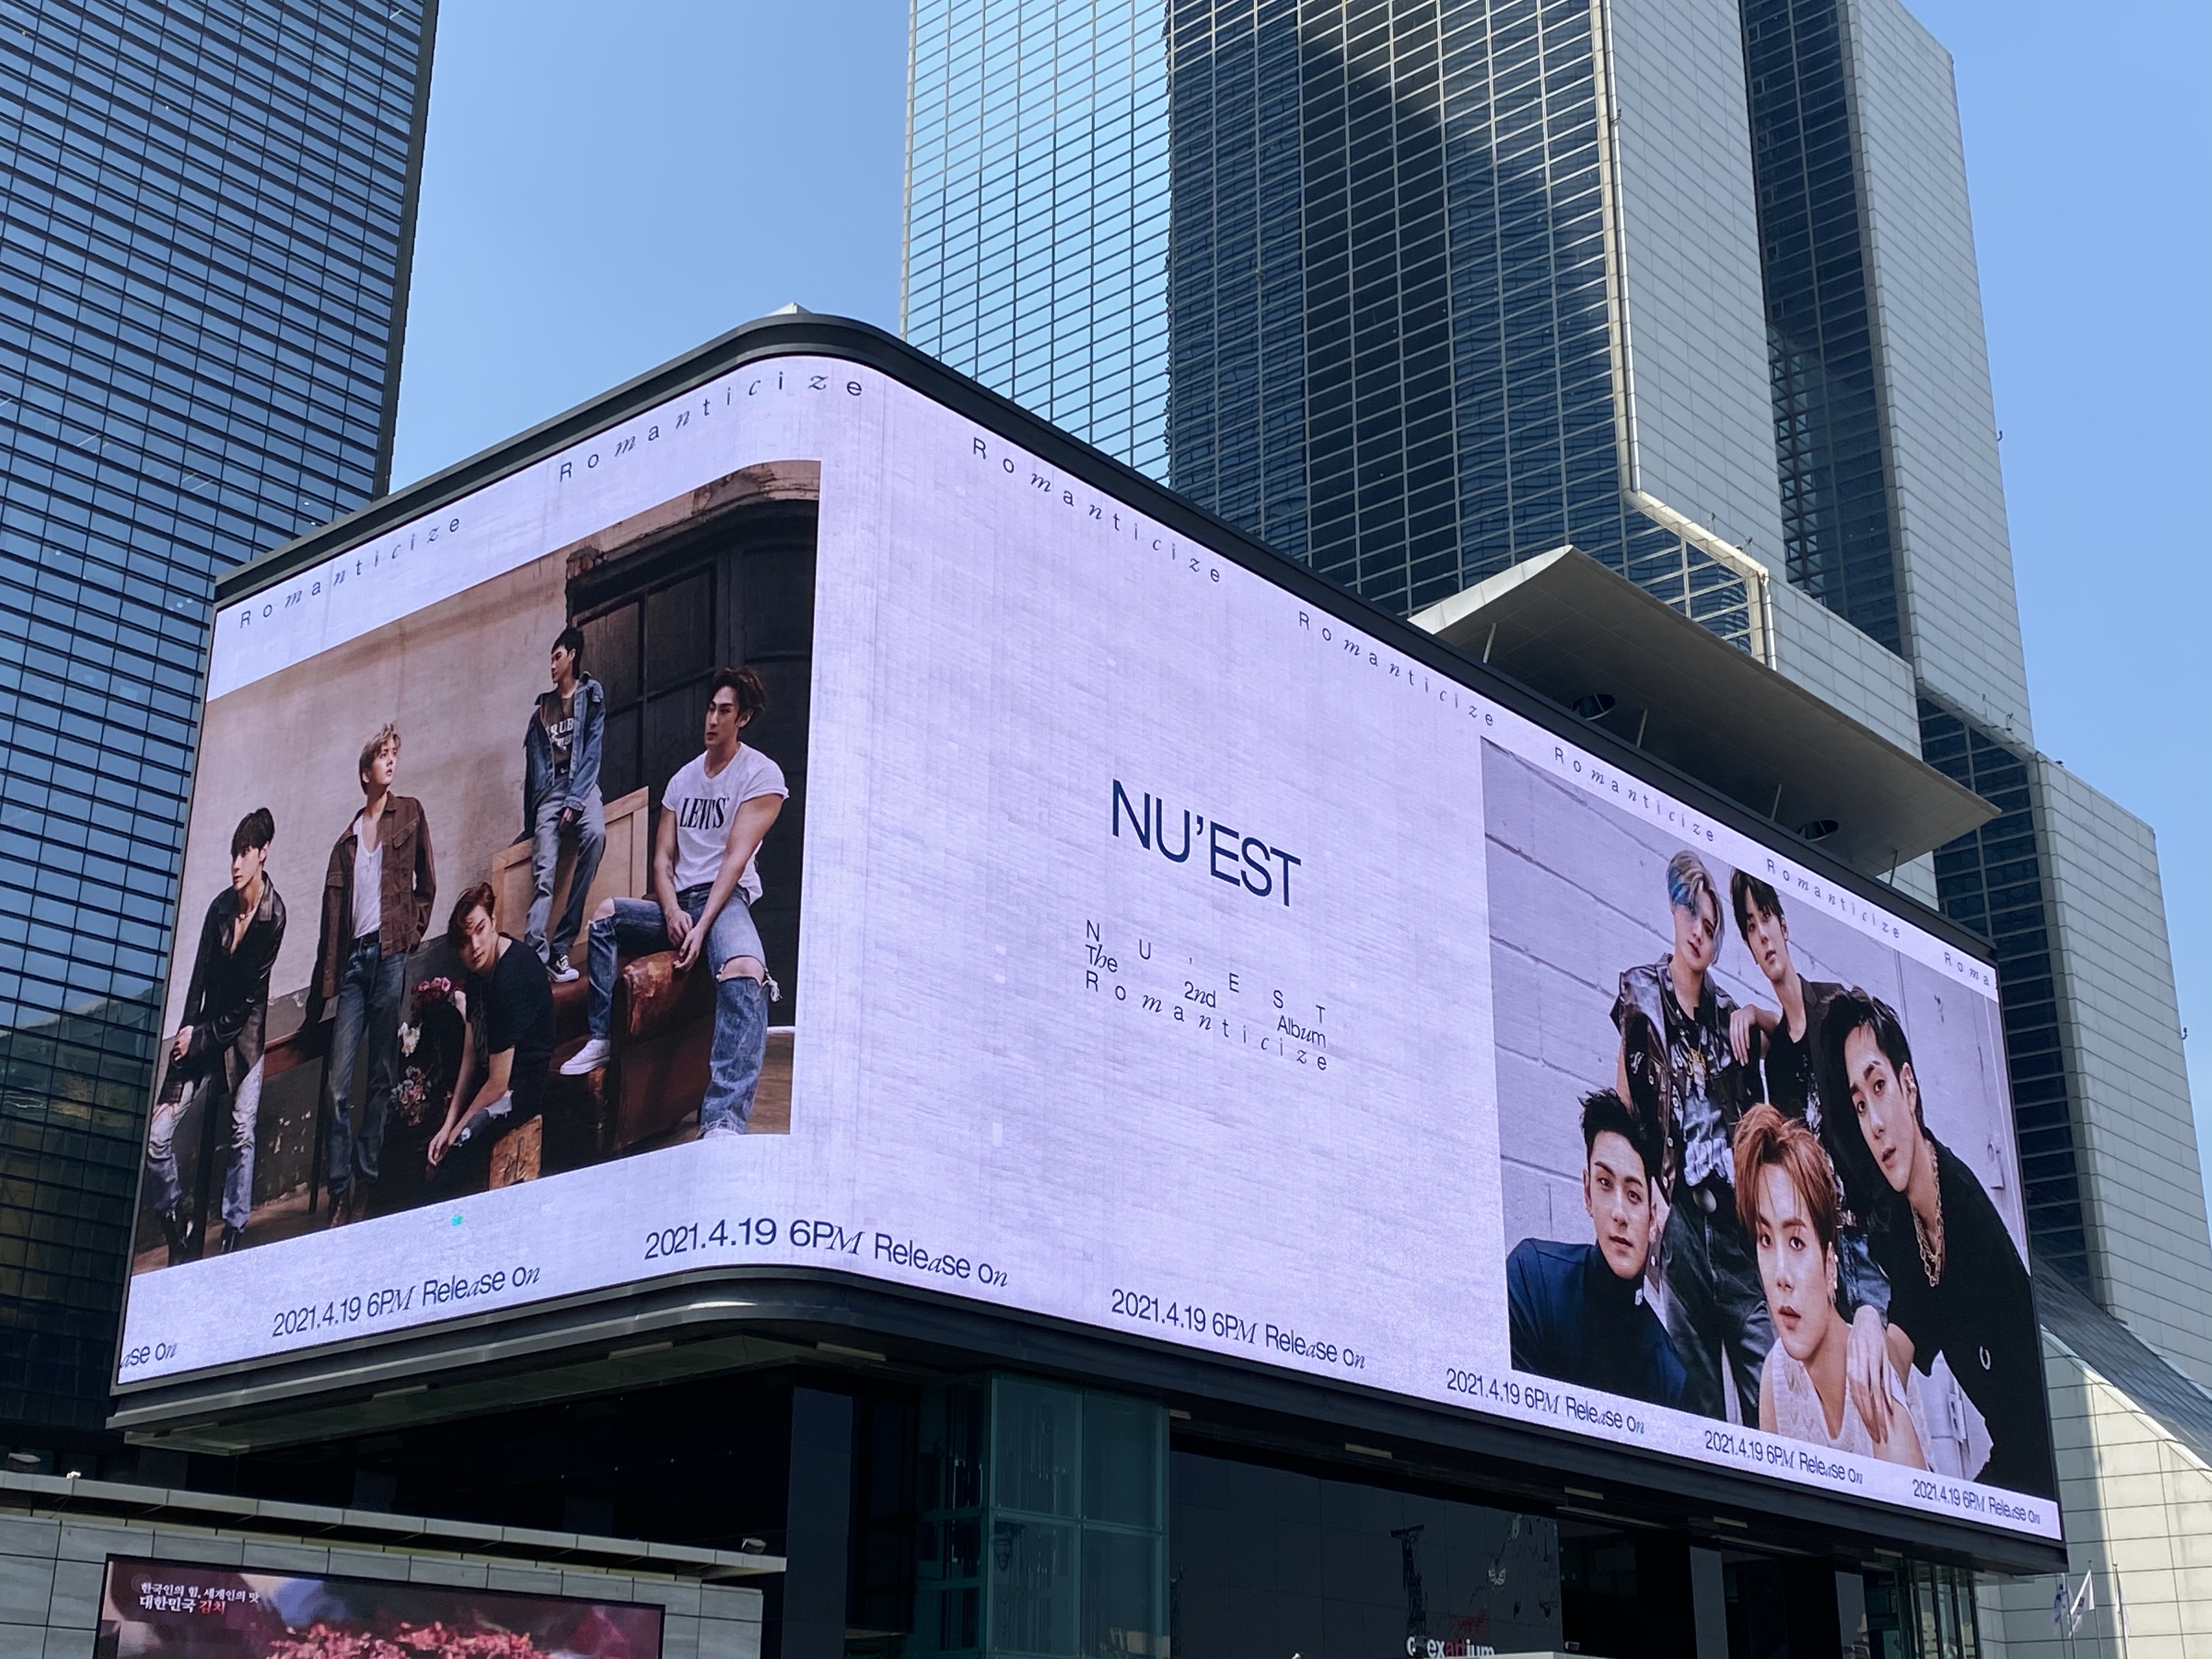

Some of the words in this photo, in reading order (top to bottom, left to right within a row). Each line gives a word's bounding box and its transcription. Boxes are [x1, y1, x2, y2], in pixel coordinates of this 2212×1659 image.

[560, 371, 862, 483] Romanticize
[973, 437, 1220, 583] Romanticize
[240, 517, 460, 629] Romanticize
[1299, 610, 1494, 726] Romanticize
[1554, 747, 1714, 842] Romanticize
[1113, 778, 1301, 907] NU'EST
[1767, 858, 1900, 938] Romanticize
[1085, 944, 1118, 973] The
[1184, 981, 1216, 1008] 2nd
[1277, 1015, 1327, 1048] Album
[1944, 951, 1997, 991] Roma
[1086, 969, 1328, 1071] Romanticize
[645, 1217, 777, 1260] 2021.4.19
[789, 1220, 866, 1256] 6PM
[874, 1232, 971, 1280] Release
[272, 1296, 362, 1337] 2021.4.19
[366, 1284, 415, 1318] 6PM
[421, 1270, 506, 1307] Release
[1111, 1288, 1206, 1333] 2021.4.19
[1212, 1312, 1259, 1345] 6PM
[1265, 1323, 1339, 1363] Release
[1447, 1368, 1520, 1404] 2021.4.19
[1525, 1386, 1560, 1414] 6PM
[1566, 1396, 1623, 1429] Release
[1705, 1430, 1763, 1462] 2021.4.19
[1767, 1444, 1795, 1469] 6PM
[1799, 1451, 1846, 1481] Release
[1912, 1479, 1961, 1507] 2021.4.19
[139, 1594, 197, 1613] 대한민국
[198, 1599, 227, 1615] 김치
[140, 1582, 185, 1597] 한국인의
[202, 1588, 247, 1603] 세계인의
[248, 1592, 261, 1604] 맛
